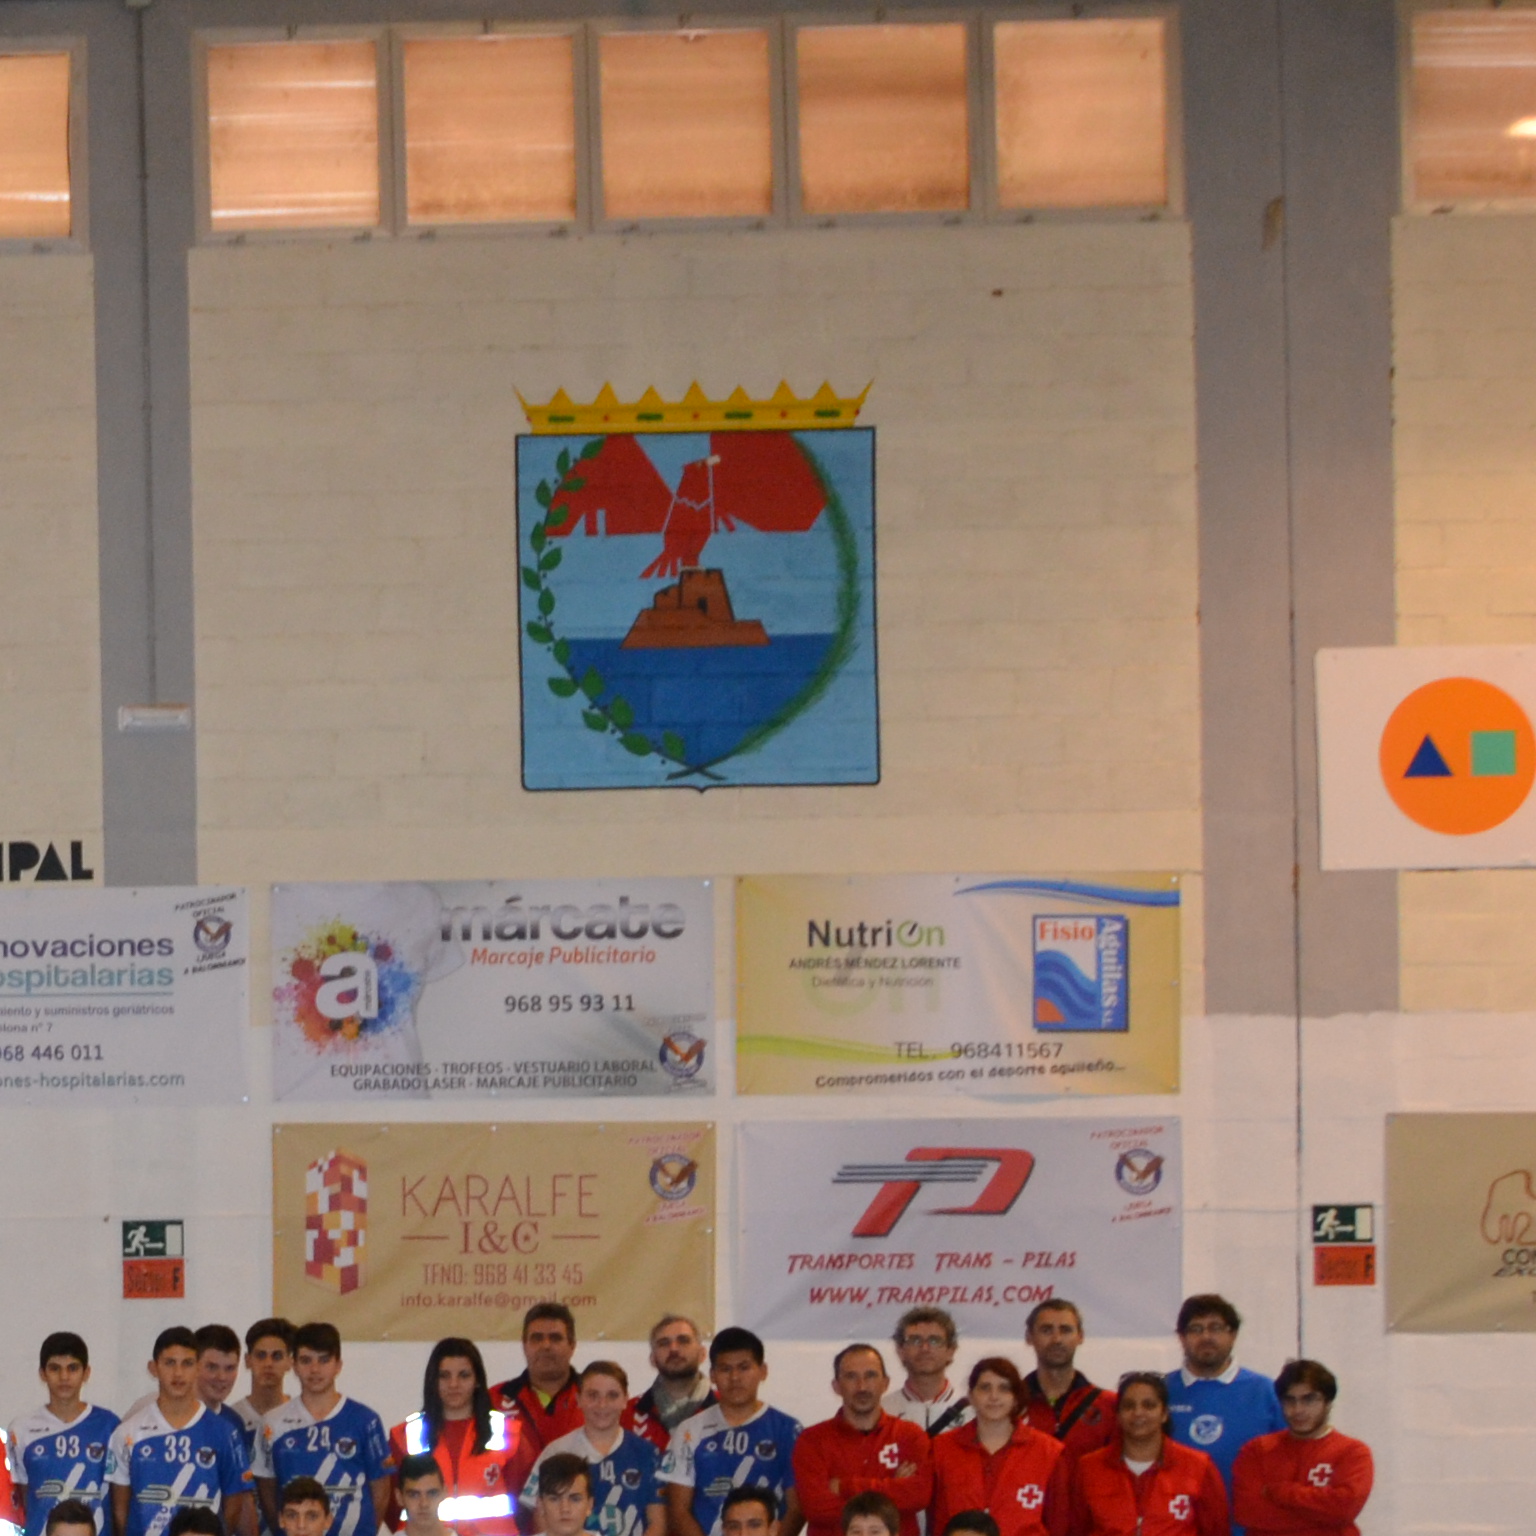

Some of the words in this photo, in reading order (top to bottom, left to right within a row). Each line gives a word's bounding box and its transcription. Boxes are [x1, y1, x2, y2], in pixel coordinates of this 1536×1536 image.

[440, 895, 686, 942] márcate
[1038, 920, 1094, 942] Fisio
[471, 946, 544, 969] Marcaje
[549, 945, 656, 965] Publicitario
[901, 958, 962, 969] LORENTE
[34, 1007, 41, 1018] y
[43, 1004, 109, 1017] suministros
[504, 996, 542, 1013] 968
[548, 995, 573, 1012] 95
[580, 994, 605, 1012] 93
[612, 994, 636, 1012] 11
[31, 1045, 64, 1061] 446
[71, 1044, 103, 1060] 011
[950, 1042, 1063, 1060] 968411567
[331, 1063, 431, 1077] EQUIPACIONES
[442, 1062, 503, 1076] TROFEOS
[513, 1061, 590, 1075] VESTUARIO
[594, 1059, 658, 1073] LABORAL
[353, 1077, 421, 1091] GRABADO
[476, 1076, 540, 1090] MARCAJE
[543, 1074, 637, 1088] PUBLICITARIO
[400, 1173, 600, 1219] KARALFE
[473, 1263, 506, 1286] 968
[534, 1263, 558, 1285] 33
[564, 1263, 583, 1285] 45
[787, 1253, 915, 1275] TRANSPORTES
[935, 1252, 992, 1275] TRANS
[1022, 1251, 1077, 1269] PILAS
[173, 1265, 180, 1290] F
[809, 1285, 1054, 1308] WWW.TRANSPILAS.COM
[54, 1433, 81, 1459] 93
[164, 1434, 191, 1462] 33
[722, 1428, 749, 1455] 40
